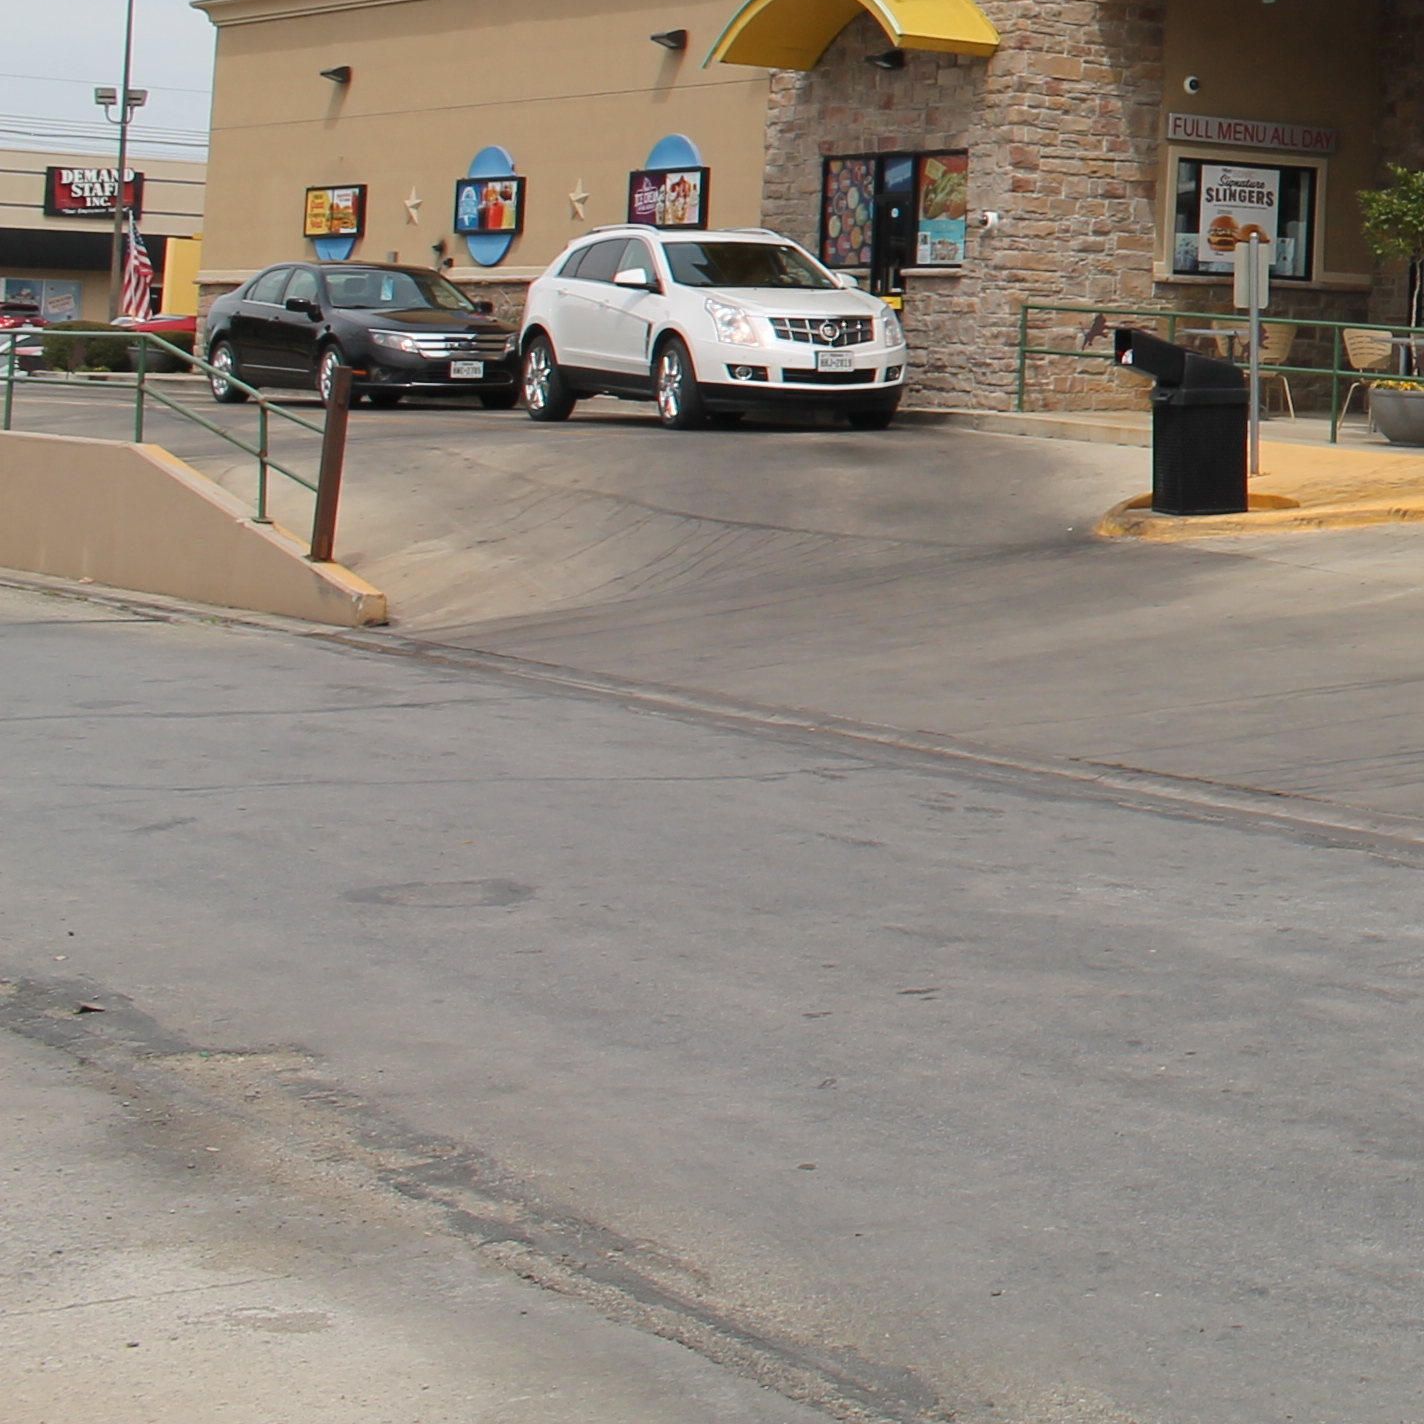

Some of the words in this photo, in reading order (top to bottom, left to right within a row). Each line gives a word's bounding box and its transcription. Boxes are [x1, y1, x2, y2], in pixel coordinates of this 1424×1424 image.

[1173, 117, 1213, 139] FULL
[1217, 121, 1267, 144] MENU
[1270, 126, 1300, 147] ALL
[1301, 129, 1334, 149] DAY
[61, 168, 136, 184] DEMAND
[1217, 174, 1266, 190] Signature
[85, 196, 111, 207] INC.
[1205, 186, 1275, 207] SLINGERS
